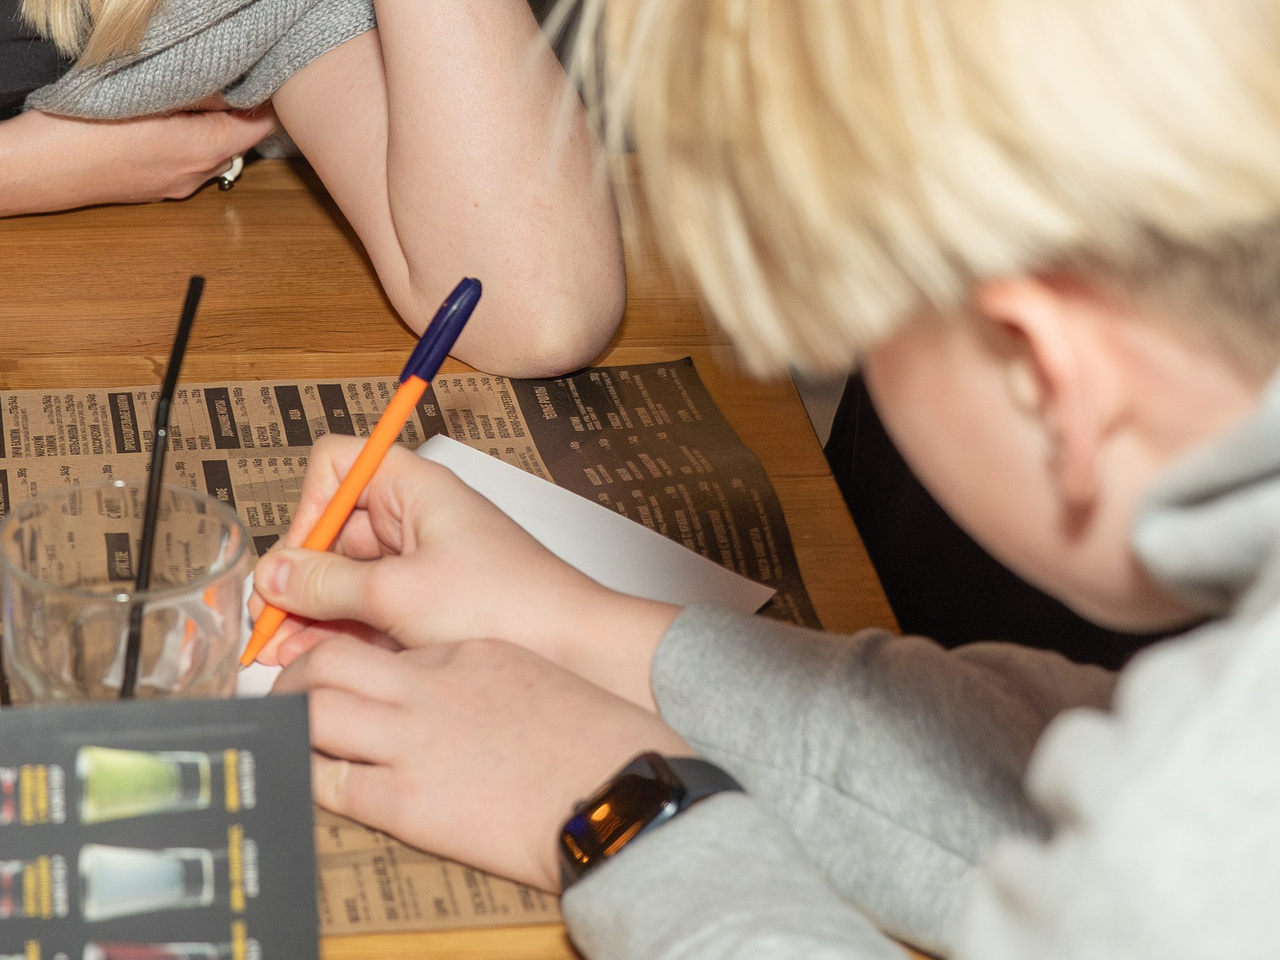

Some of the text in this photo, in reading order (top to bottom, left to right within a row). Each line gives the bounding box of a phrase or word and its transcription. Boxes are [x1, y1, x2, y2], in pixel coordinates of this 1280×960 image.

[214, 400, 234, 437] ДОМАШНИЕ МОРСЫ
[288, 408, 302, 420] ВОДА
[332, 408, 345, 418] СОК
[423, 403, 437, 417] ФРЕШ
[119, 411, 136, 451] ПРОХЛАДИТЕЛЬНЫЕ
[460, 408, 480, 440] АПЕЛЬСИНОВЫЙ
[476, 414, 496, 440] МОРКОВНЫЙ
[492, 417, 511, 439] ЯБЛОЧНЫЙ
[65, 424, 81, 455] АПЕЛЬСИНОВЫЙ
[88, 424, 104, 455] КЛАССИЧЕСКИЙ
[186, 437, 197, 451] ФАНТА
[199, 435, 212, 450] СПРАЙТ
[215, 487, 229, 501] КОФЕ
[246, 506, 261, 527] ЭСПРЕССО
[261, 502, 276, 526] АМЕРИКАНО
